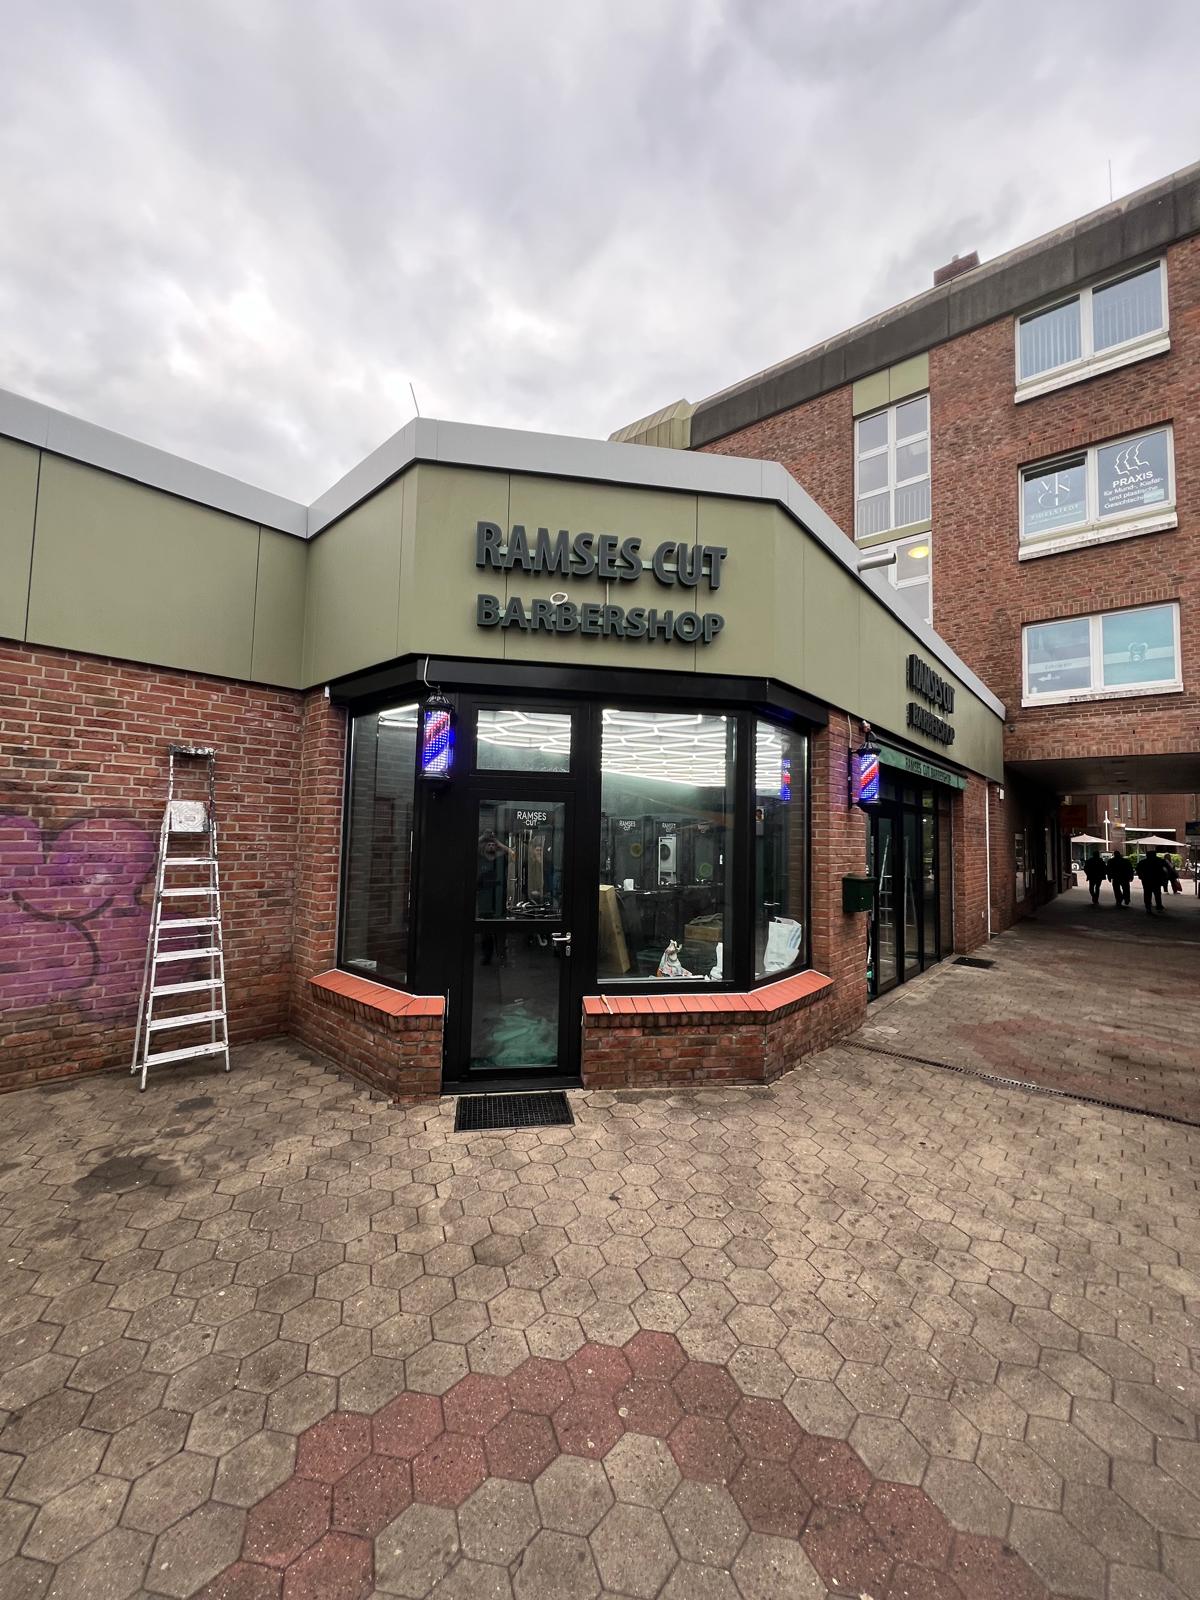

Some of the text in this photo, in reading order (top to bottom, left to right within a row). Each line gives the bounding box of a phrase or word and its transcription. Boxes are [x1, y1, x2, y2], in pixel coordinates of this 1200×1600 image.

[1112, 470, 1154, 488] PRAXIS
[476, 521, 728, 590] RAMSES CUT
[476, 593, 725, 643] BARBERSHOP
[516, 810, 547, 821] RAMSES
